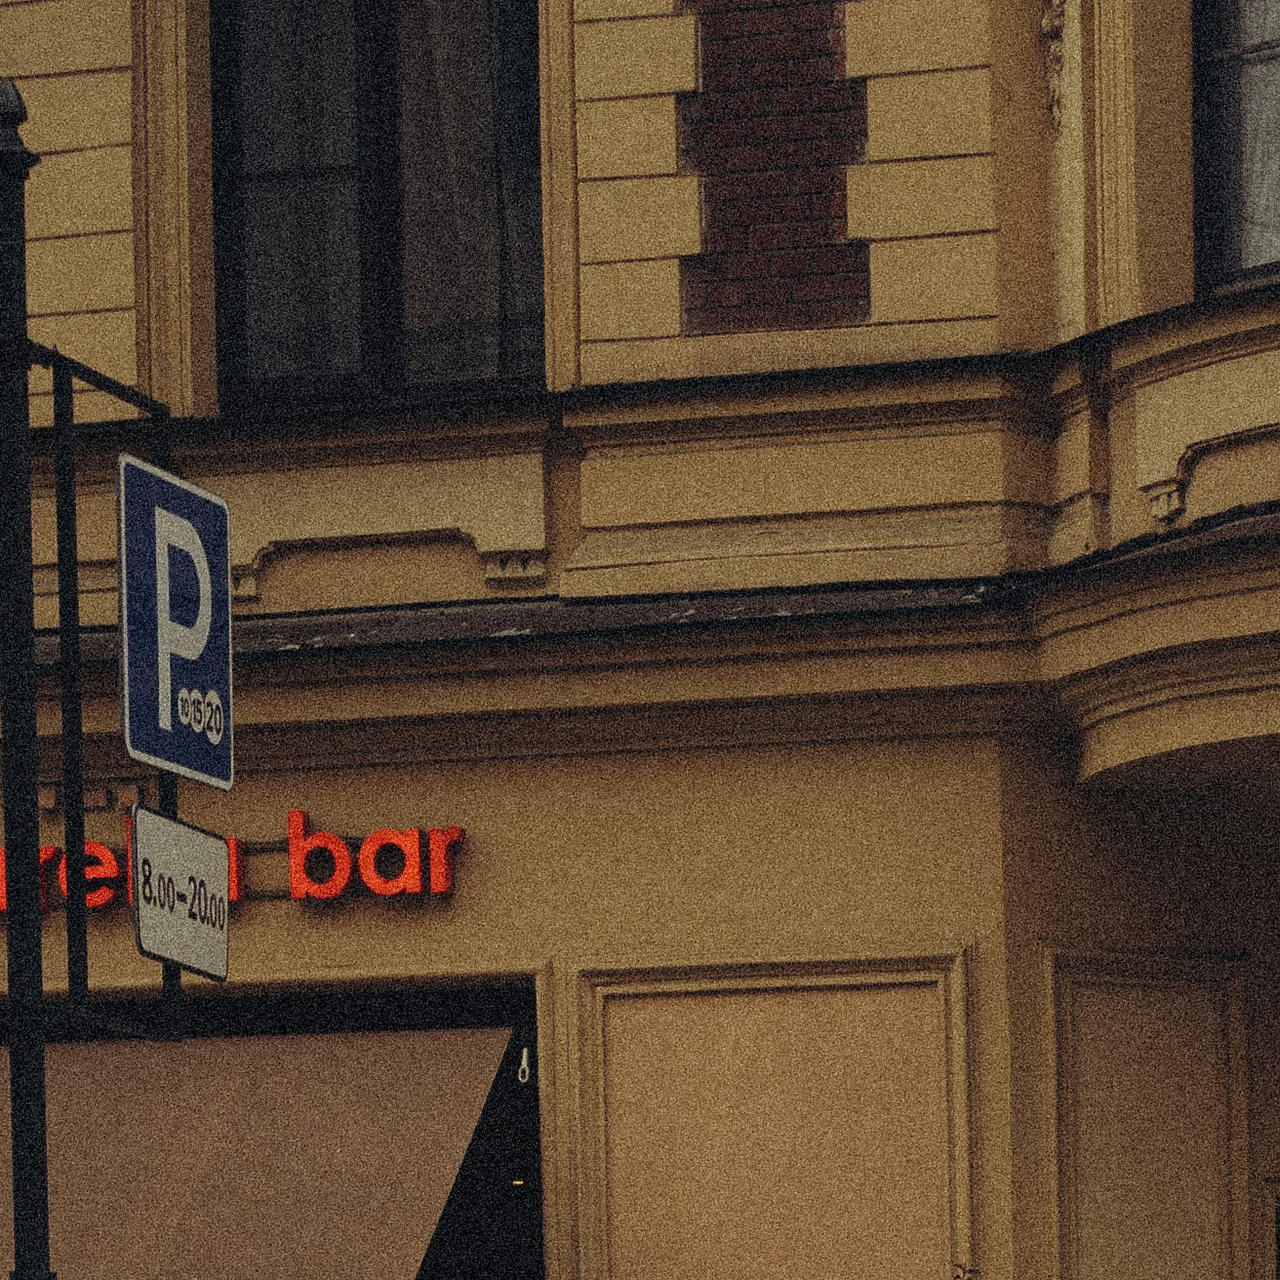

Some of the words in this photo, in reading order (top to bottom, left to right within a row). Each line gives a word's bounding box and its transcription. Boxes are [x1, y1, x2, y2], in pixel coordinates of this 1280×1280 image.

[155, 506, 213, 732] P
[206, 701, 222, 735] 20
[288, 810, 466, 901] bar
